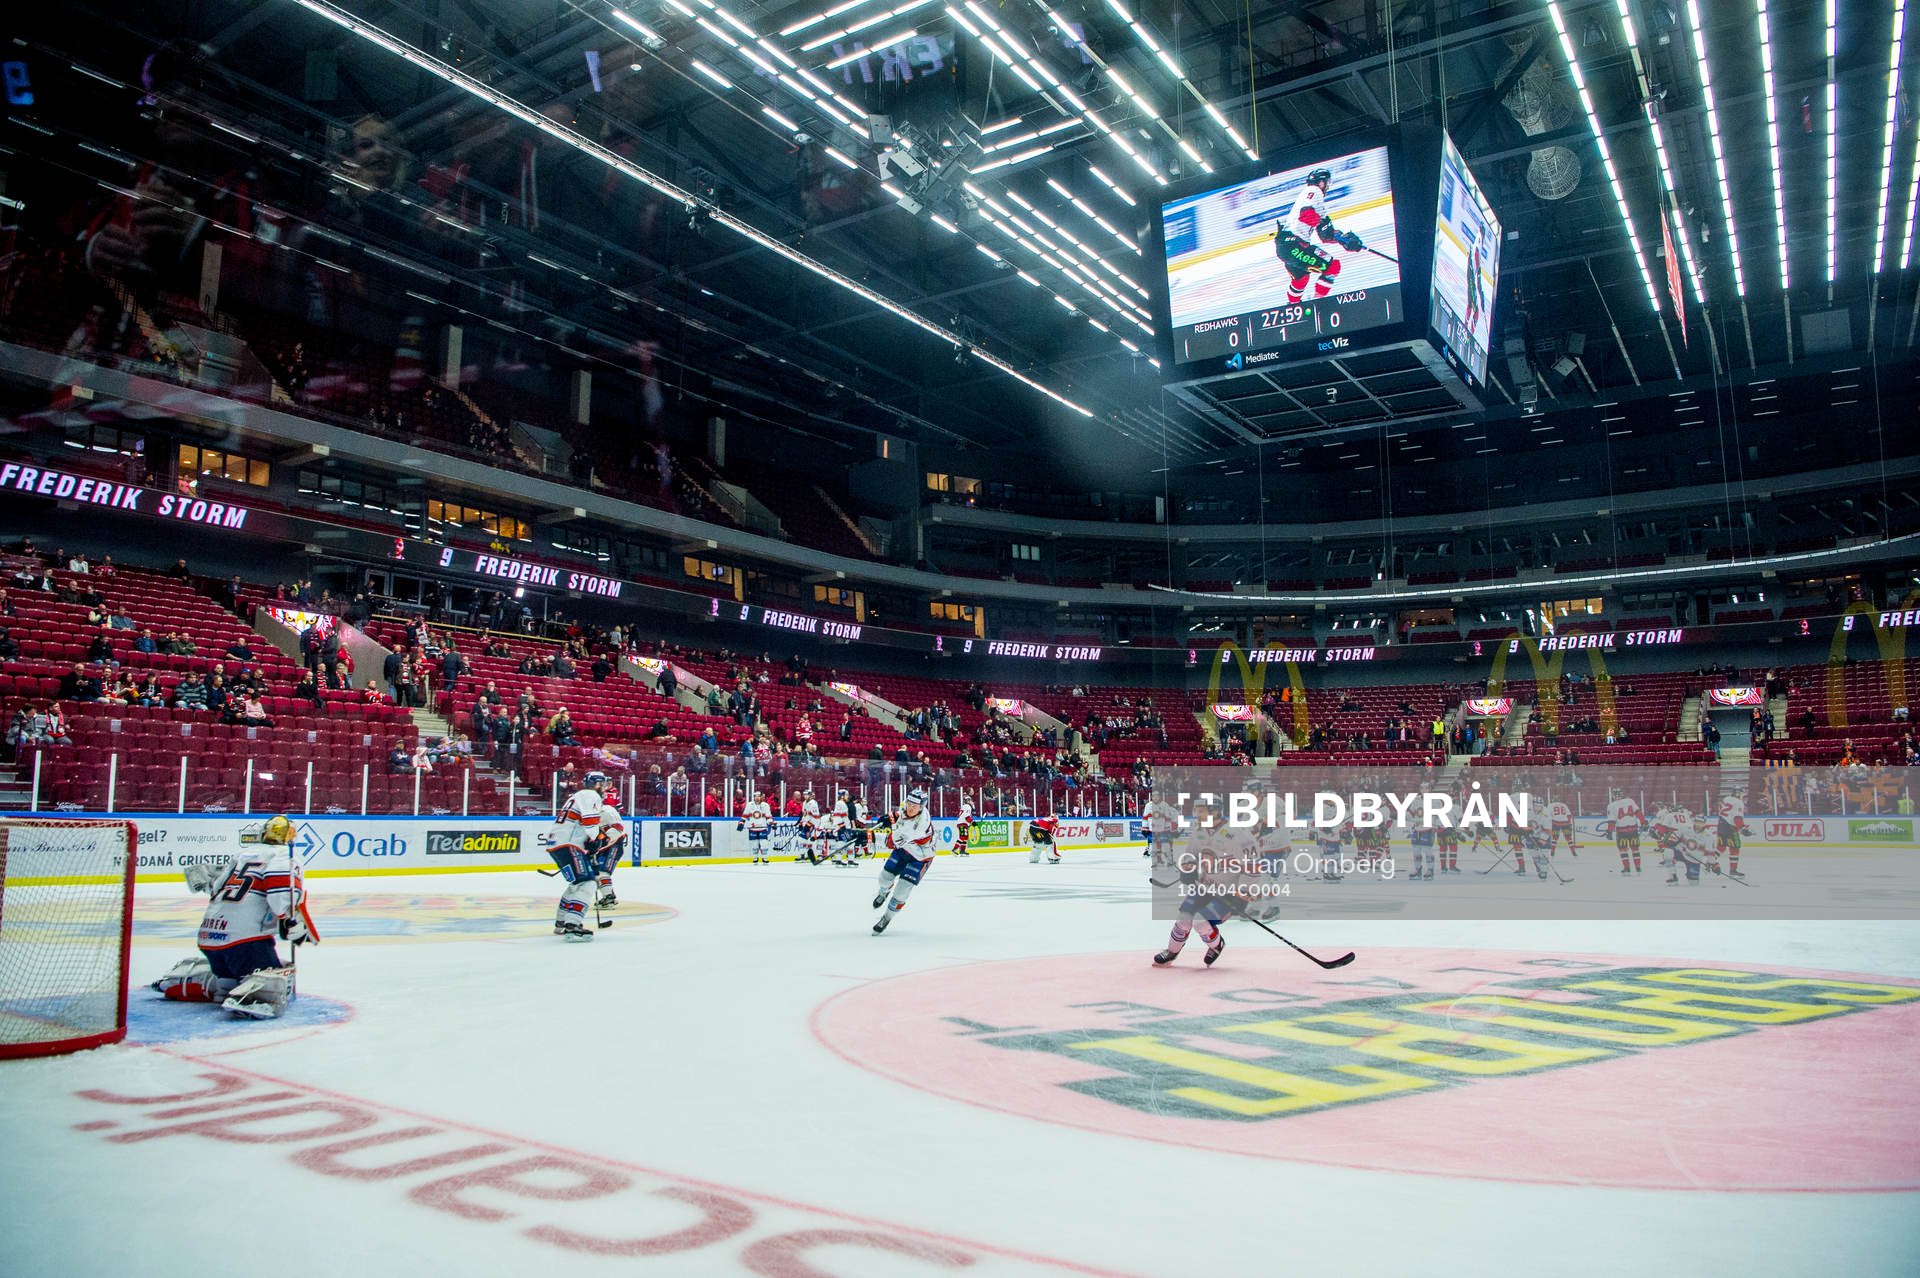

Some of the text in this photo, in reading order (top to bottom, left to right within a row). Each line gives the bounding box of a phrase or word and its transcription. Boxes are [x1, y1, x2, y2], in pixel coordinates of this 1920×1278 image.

[1337, 290, 1366, 305] VÄXJÖ
[1194, 317, 1239, 333] REDHAWKS
[1261, 306, 1303, 328] 27:59
[1330, 312, 1340, 327] 0
[1229, 332, 1239, 347] 0
[1279, 328, 1286, 341] 1
[1318, 337, 1349, 351] tecViz
[1246, 351, 1280, 364] Mediatec
[0, 463, 248, 529] FREDERIK STORM
[439, 547, 622, 598] 9 FREDERIK STORM
[740, 605, 862, 641] 9 FREDERIK STORM
[1842, 615, 1855, 631] 9
[1508, 629, 1683, 653] 9 FREDERIK STORM
[963, 639, 1101, 661] 9 FREDERIK STORM
[1222, 647, 1375, 663] 9 FREDERIK STORM
[981, 824, 1007, 835] GASAB
[1767, 823, 1822, 837] JULA
[177, 834, 227, 845] www.grus.nu
[332, 831, 406, 857] Ocab
[428, 833, 518, 851] Tedadmin
[664, 831, 704, 848] RSA
[113, 851, 173, 867] NRDANÅ
